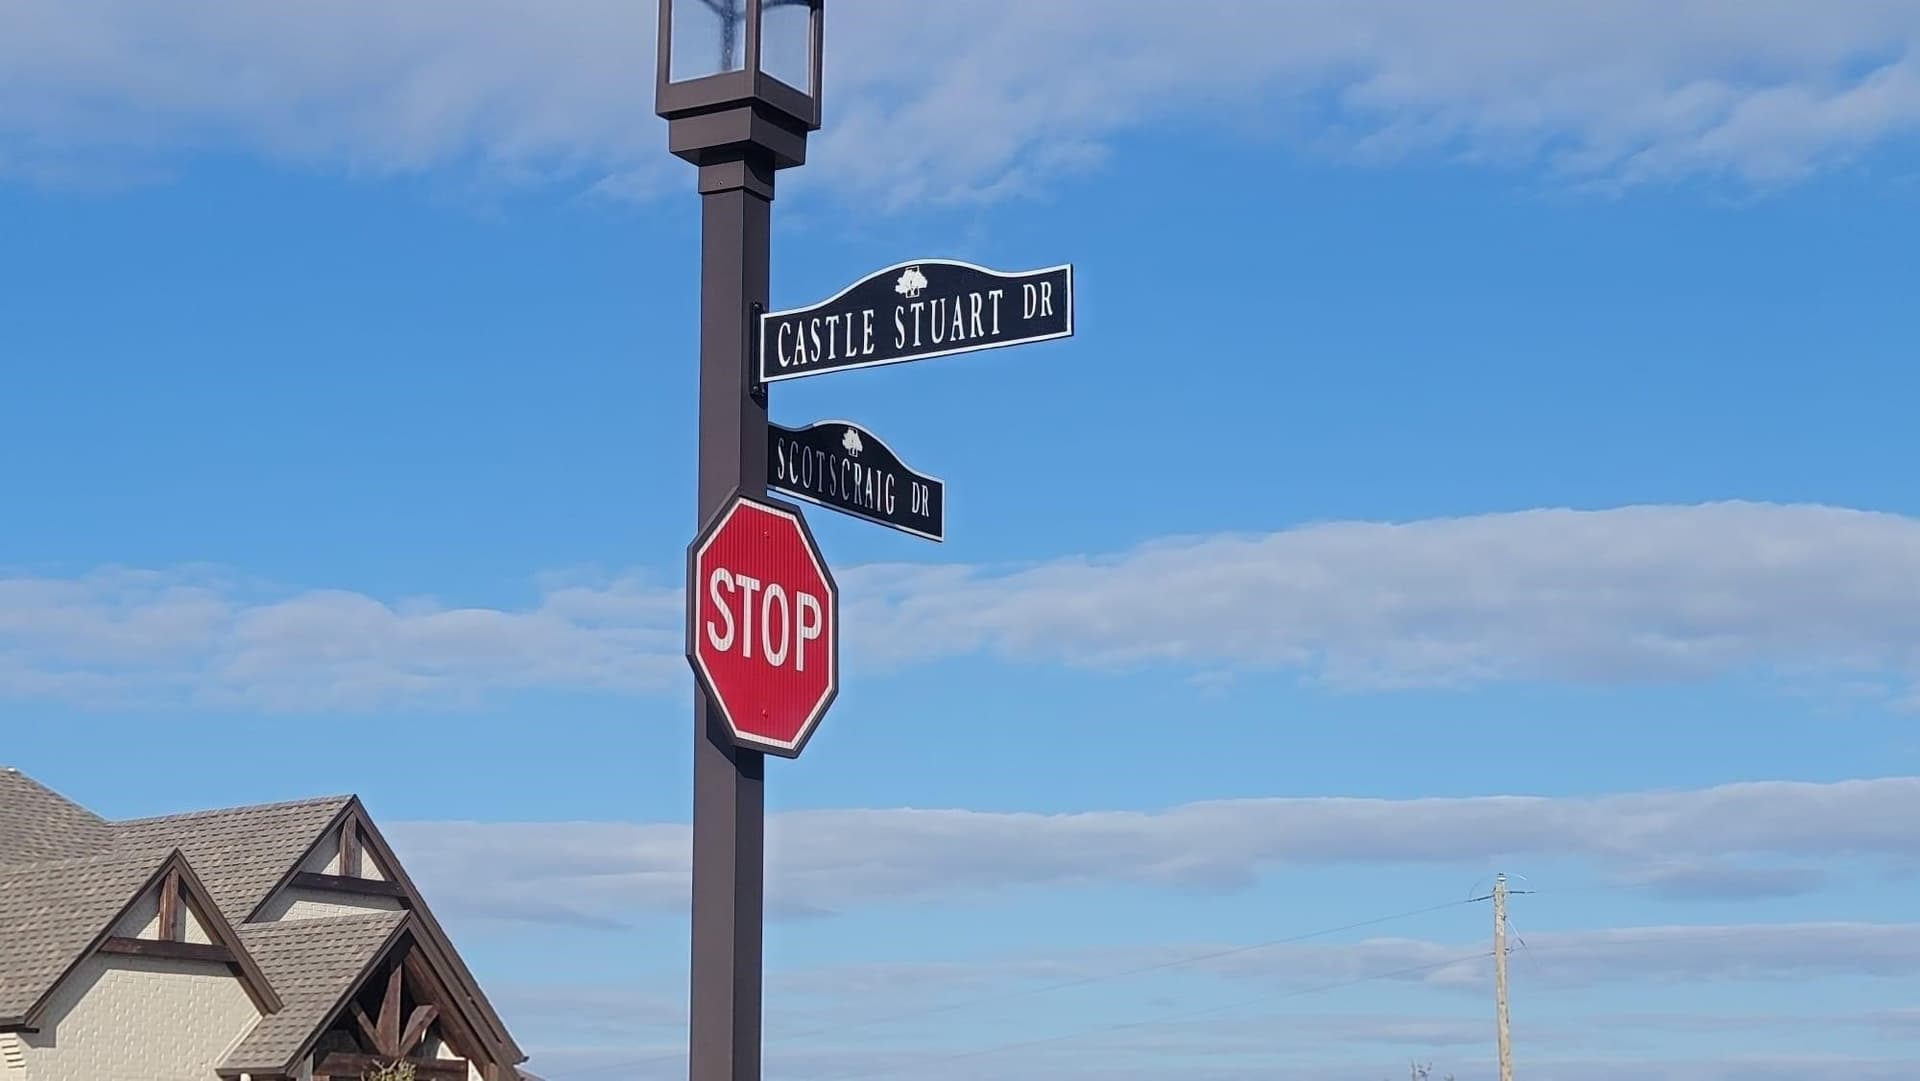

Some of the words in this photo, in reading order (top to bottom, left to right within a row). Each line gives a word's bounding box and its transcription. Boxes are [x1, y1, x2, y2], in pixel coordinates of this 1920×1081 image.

[777, 309, 875, 368] CASTLE
[894, 289, 1003, 350] STUART
[1022, 281, 1053, 320] DR
[777, 437, 895, 515] SCOTSCRAIG
[912, 481, 930, 517] DR
[707, 567, 822, 672] STOP
